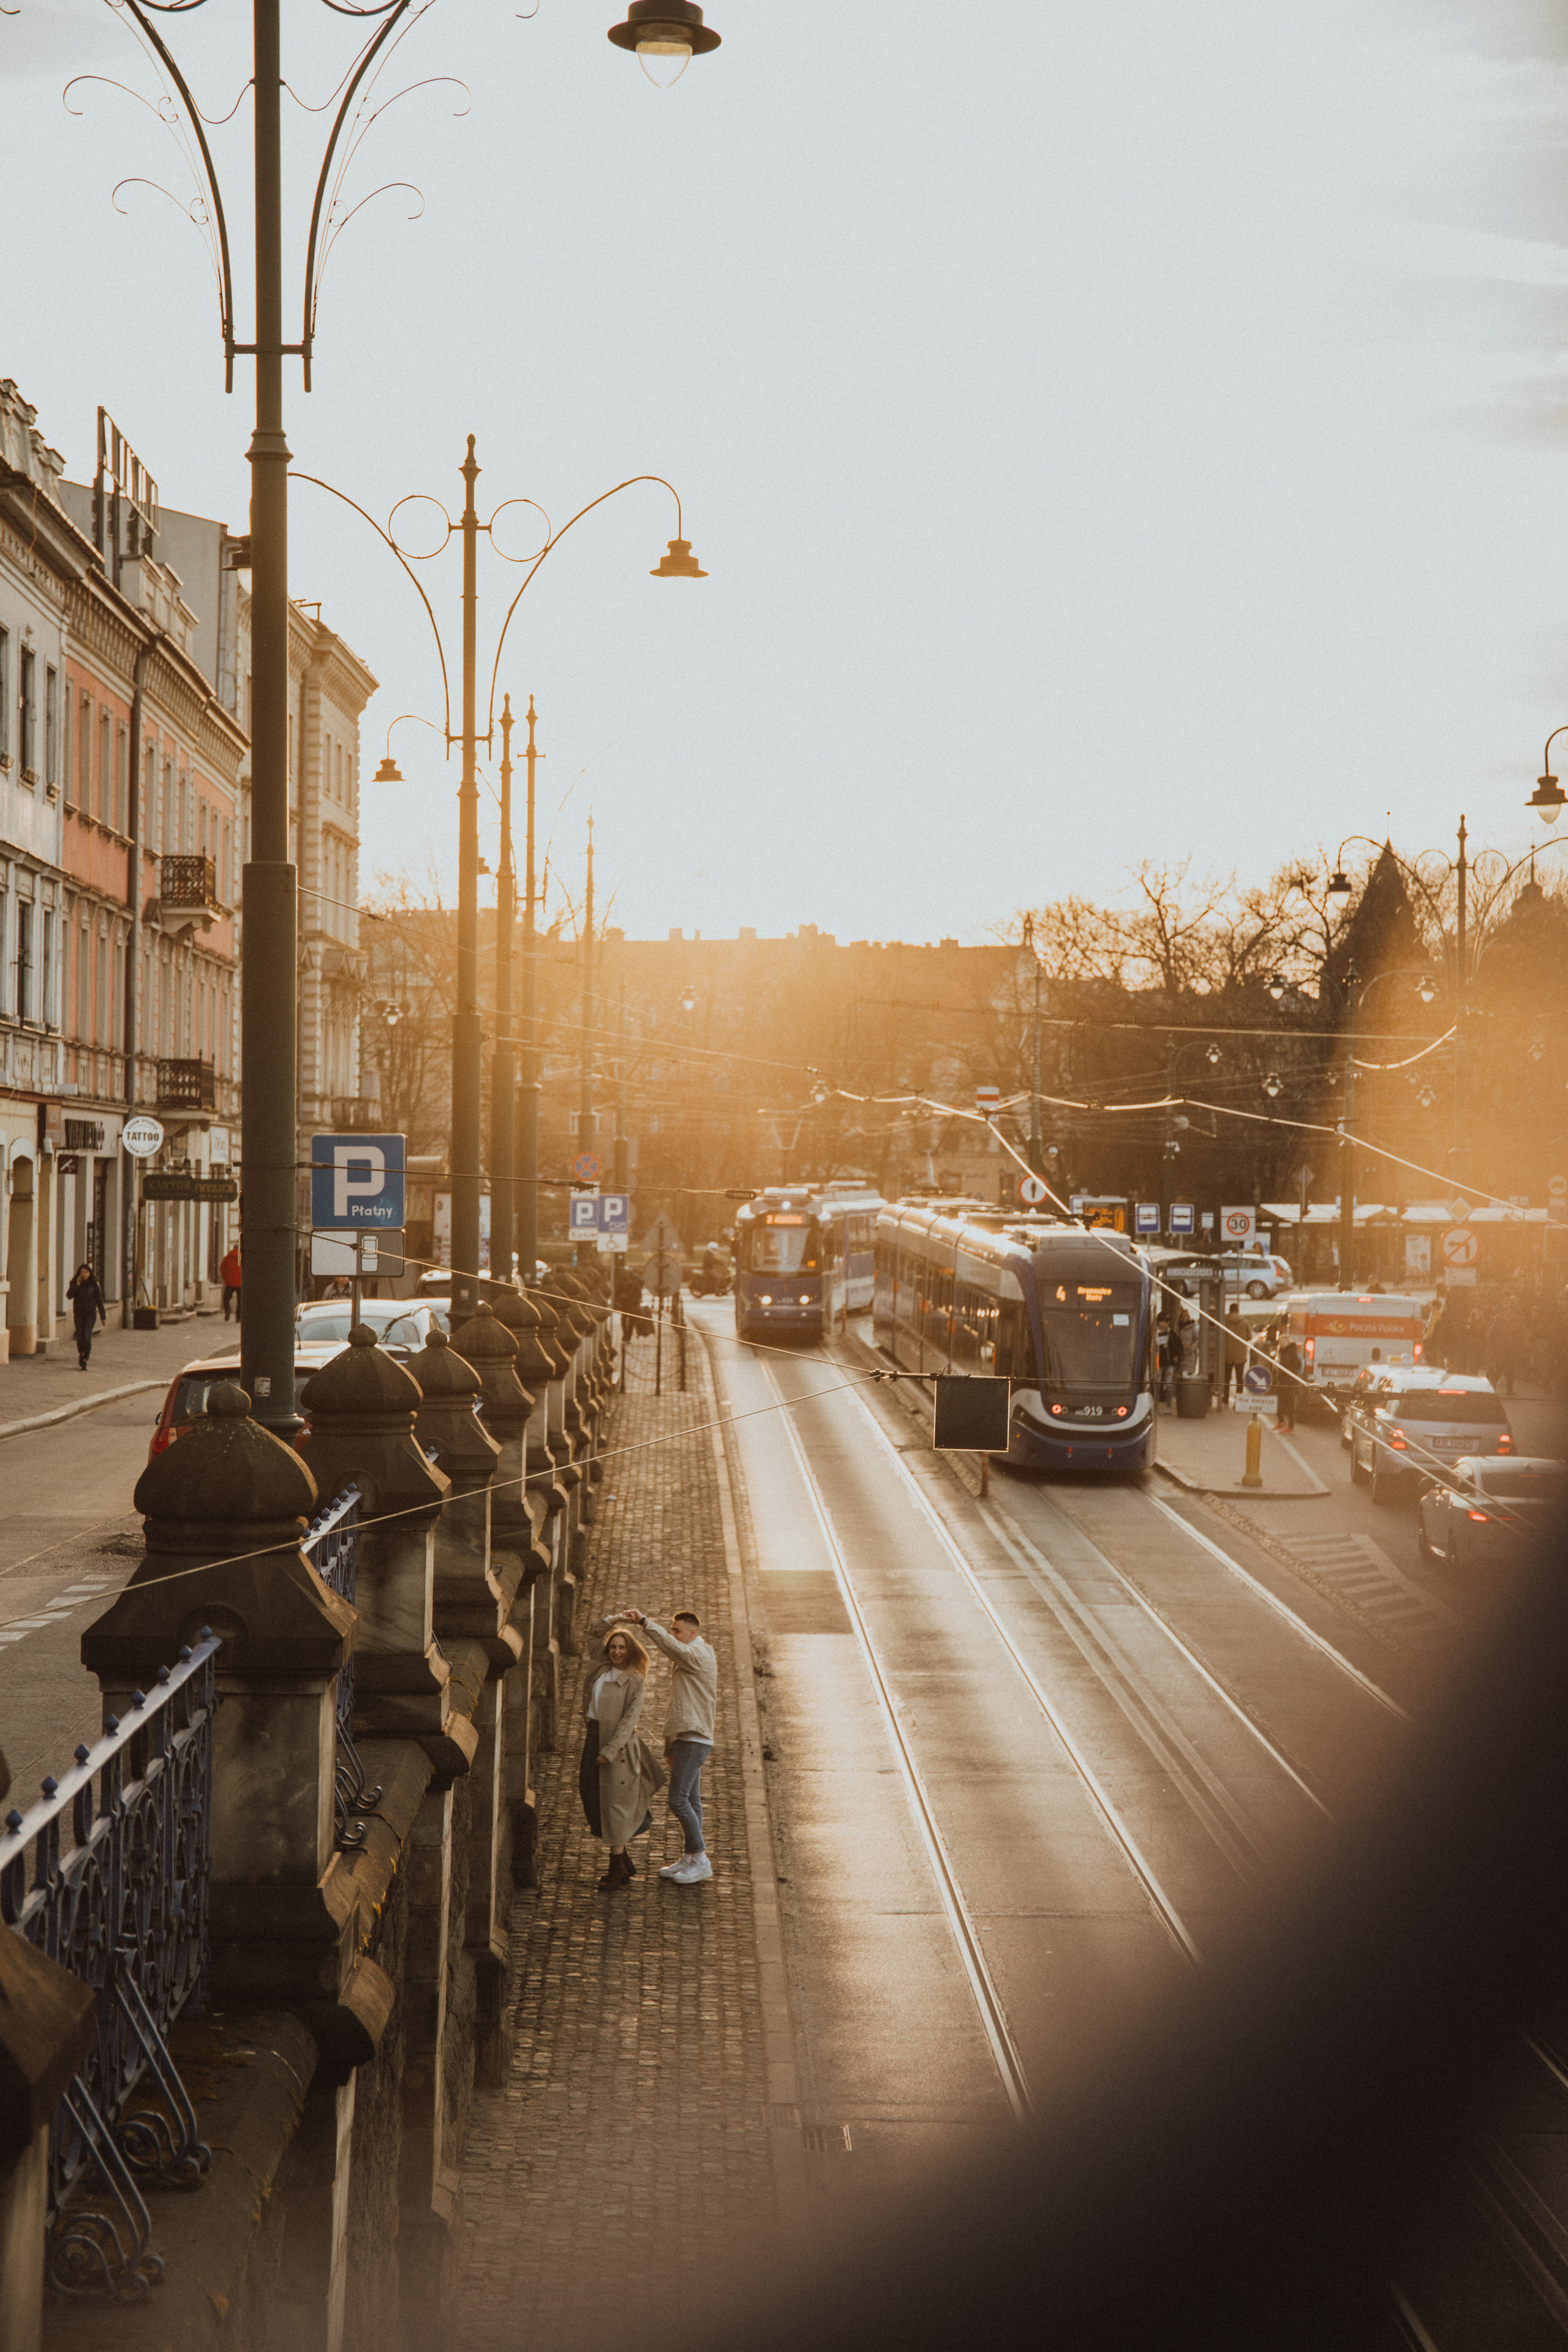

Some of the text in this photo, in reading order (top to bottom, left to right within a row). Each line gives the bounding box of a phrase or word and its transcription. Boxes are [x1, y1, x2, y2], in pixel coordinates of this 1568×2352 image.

[127, 1132, 159, 1141] TATTOO
[148, 1180, 190, 1190] KANTOR
[334, 1146, 385, 1216] P
[352, 1205, 393, 1218] Płatny
[576, 1202, 594, 1225] P
[604, 1197, 622, 1223] P
[1231, 1219, 1246, 1230] 30
[1057, 1286, 1066, 1302] 4
[1349, 1322, 1404, 1333] Poczta Polska
